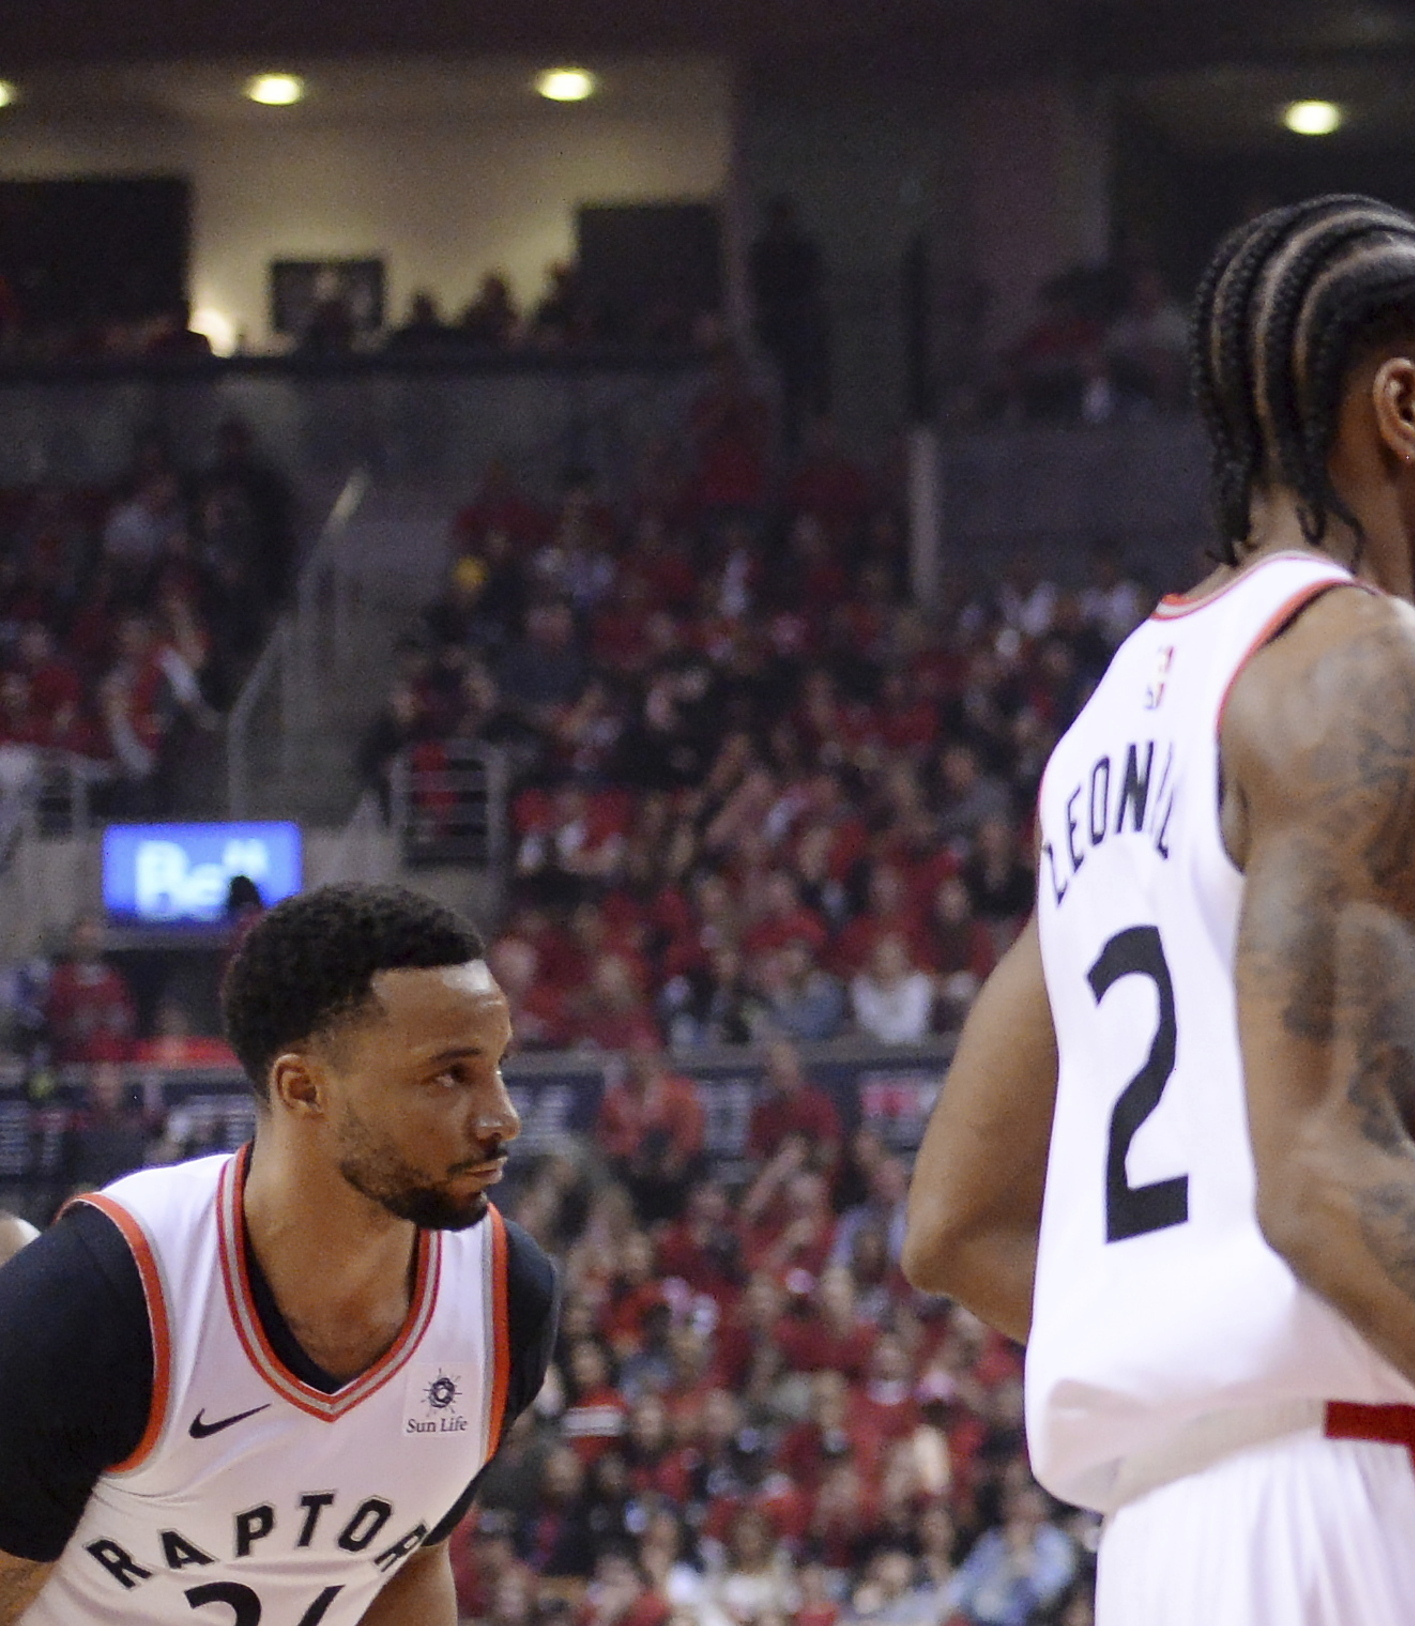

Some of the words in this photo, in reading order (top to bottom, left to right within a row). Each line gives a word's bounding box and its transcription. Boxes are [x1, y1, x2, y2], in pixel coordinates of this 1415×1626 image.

[1087, 925, 1189, 1244] 2
[406, 1418, 437, 1434] Sun
[440, 1415, 468, 1432] Life
